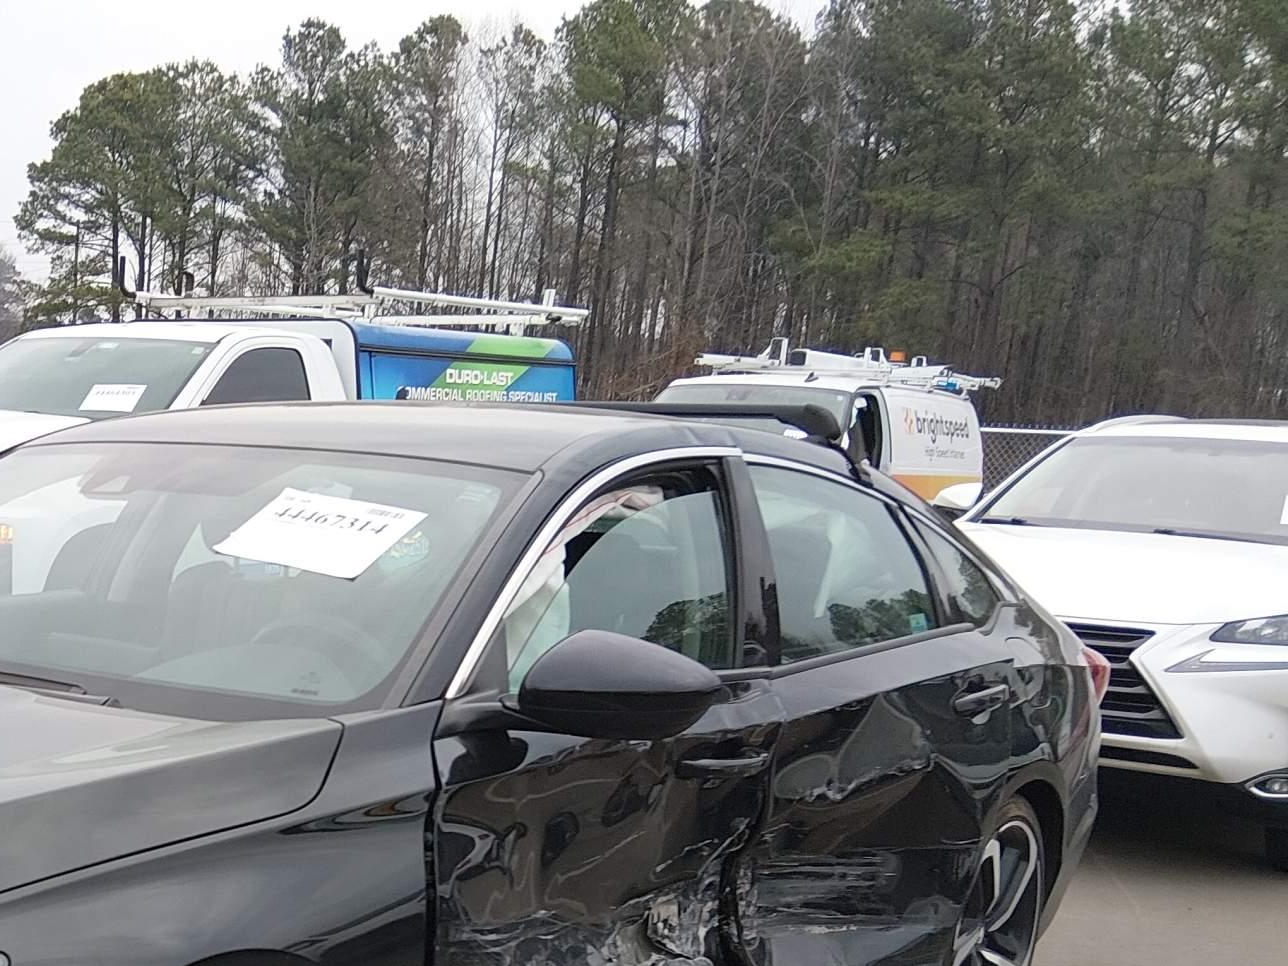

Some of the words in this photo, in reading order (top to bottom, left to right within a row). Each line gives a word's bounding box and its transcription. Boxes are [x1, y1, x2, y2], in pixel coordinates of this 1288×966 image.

[466, 388, 507, 402] ROOFING
[508, 390, 558, 403] SPECIALIST
[914, 409, 970, 444] brightspeed
[274, 507, 390, 535] 44467314
